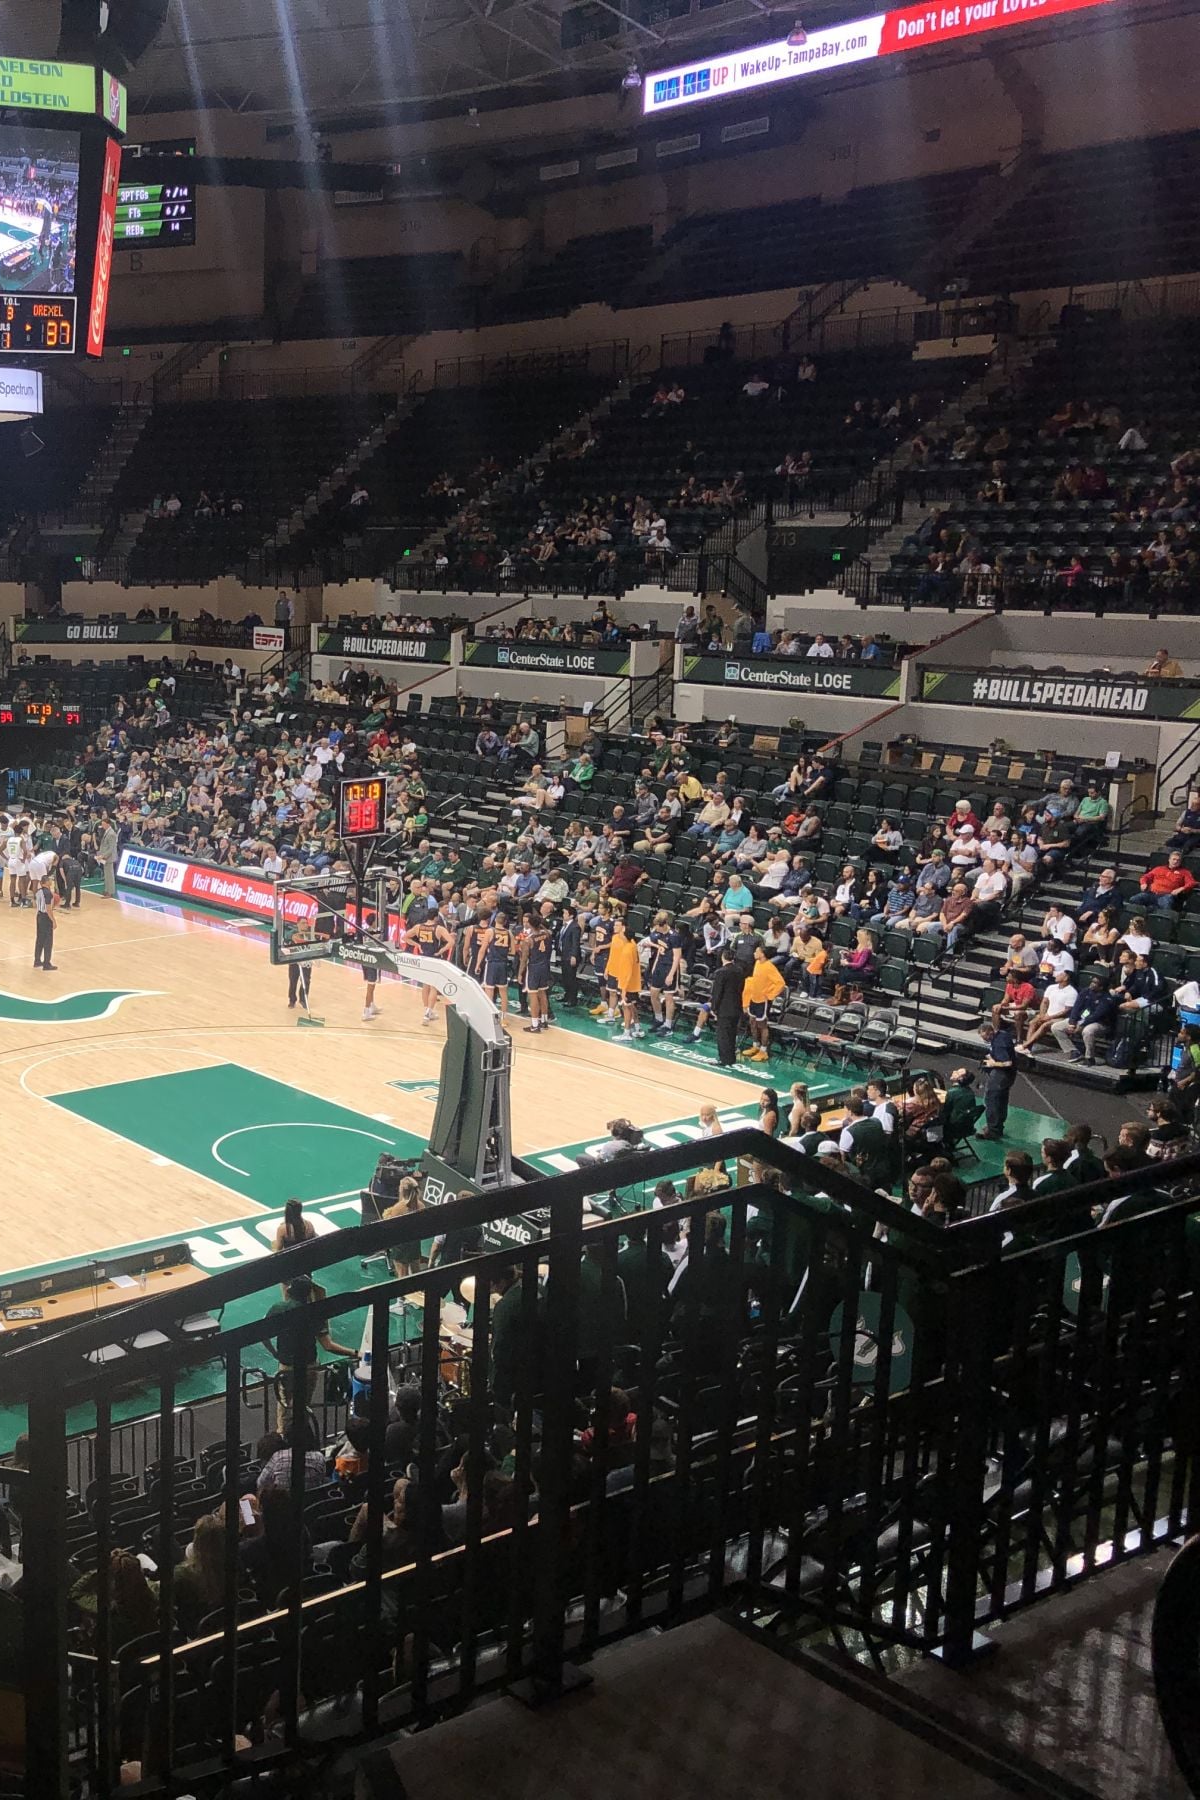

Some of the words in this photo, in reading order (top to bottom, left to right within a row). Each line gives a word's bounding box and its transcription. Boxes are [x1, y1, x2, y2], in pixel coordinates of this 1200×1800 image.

[897, 16, 937, 40] Don't
[941, 10, 960, 30] let
[965, 1, 998, 26] your
[1003, 0, 1047, 14] LOV
[653, 67, 711, 104] WAKE
[712, 66, 729, 87] UP
[740, 34, 868, 78] WakeUp-TampaBay.com
[120, 190, 134, 202] 3PT
[135, 189, 149, 201] FGs
[128, 207, 142, 219] FTs
[125, 224, 145, 236] REBs
[171, 222, 180, 231] 14
[130, 253, 144, 272] B
[6, 306, 14, 321] 3
[33, 303, 64, 317] DREXEL
[46, 321, 72, 346] 37
[0, 381, 31, 398] Spectrum
[771, 531, 797, 546] 213
[66, 625, 80, 639] GO
[82, 625, 119, 639] BULLS!
[254, 632, 285, 648] ESPN
[342, 636, 426, 658] #BULLSPEEDAHEAD
[509, 650, 565, 668] CenterState
[566, 655, 596, 670] LOGE
[739, 666, 812, 687] CenterState
[814, 671, 852, 690] LOGE
[972, 678, 1150, 712] #BULLSPEEDAHEAD
[0, 712, 13, 724] 39
[26, 704, 52, 716] 17:13
[40, 716, 46, 725] 2
[166, 866, 179, 884] UP
[192, 873, 210, 890] Visit
[209, 877, 308, 918] WakeUp-Tampaay.com
[419, 930, 434, 943] 51
[494, 933, 509, 948] 21
[538, 938, 546, 953] 4
[338, 945, 374, 964] Spectrum
[394, 954, 421, 968] SPALDING
